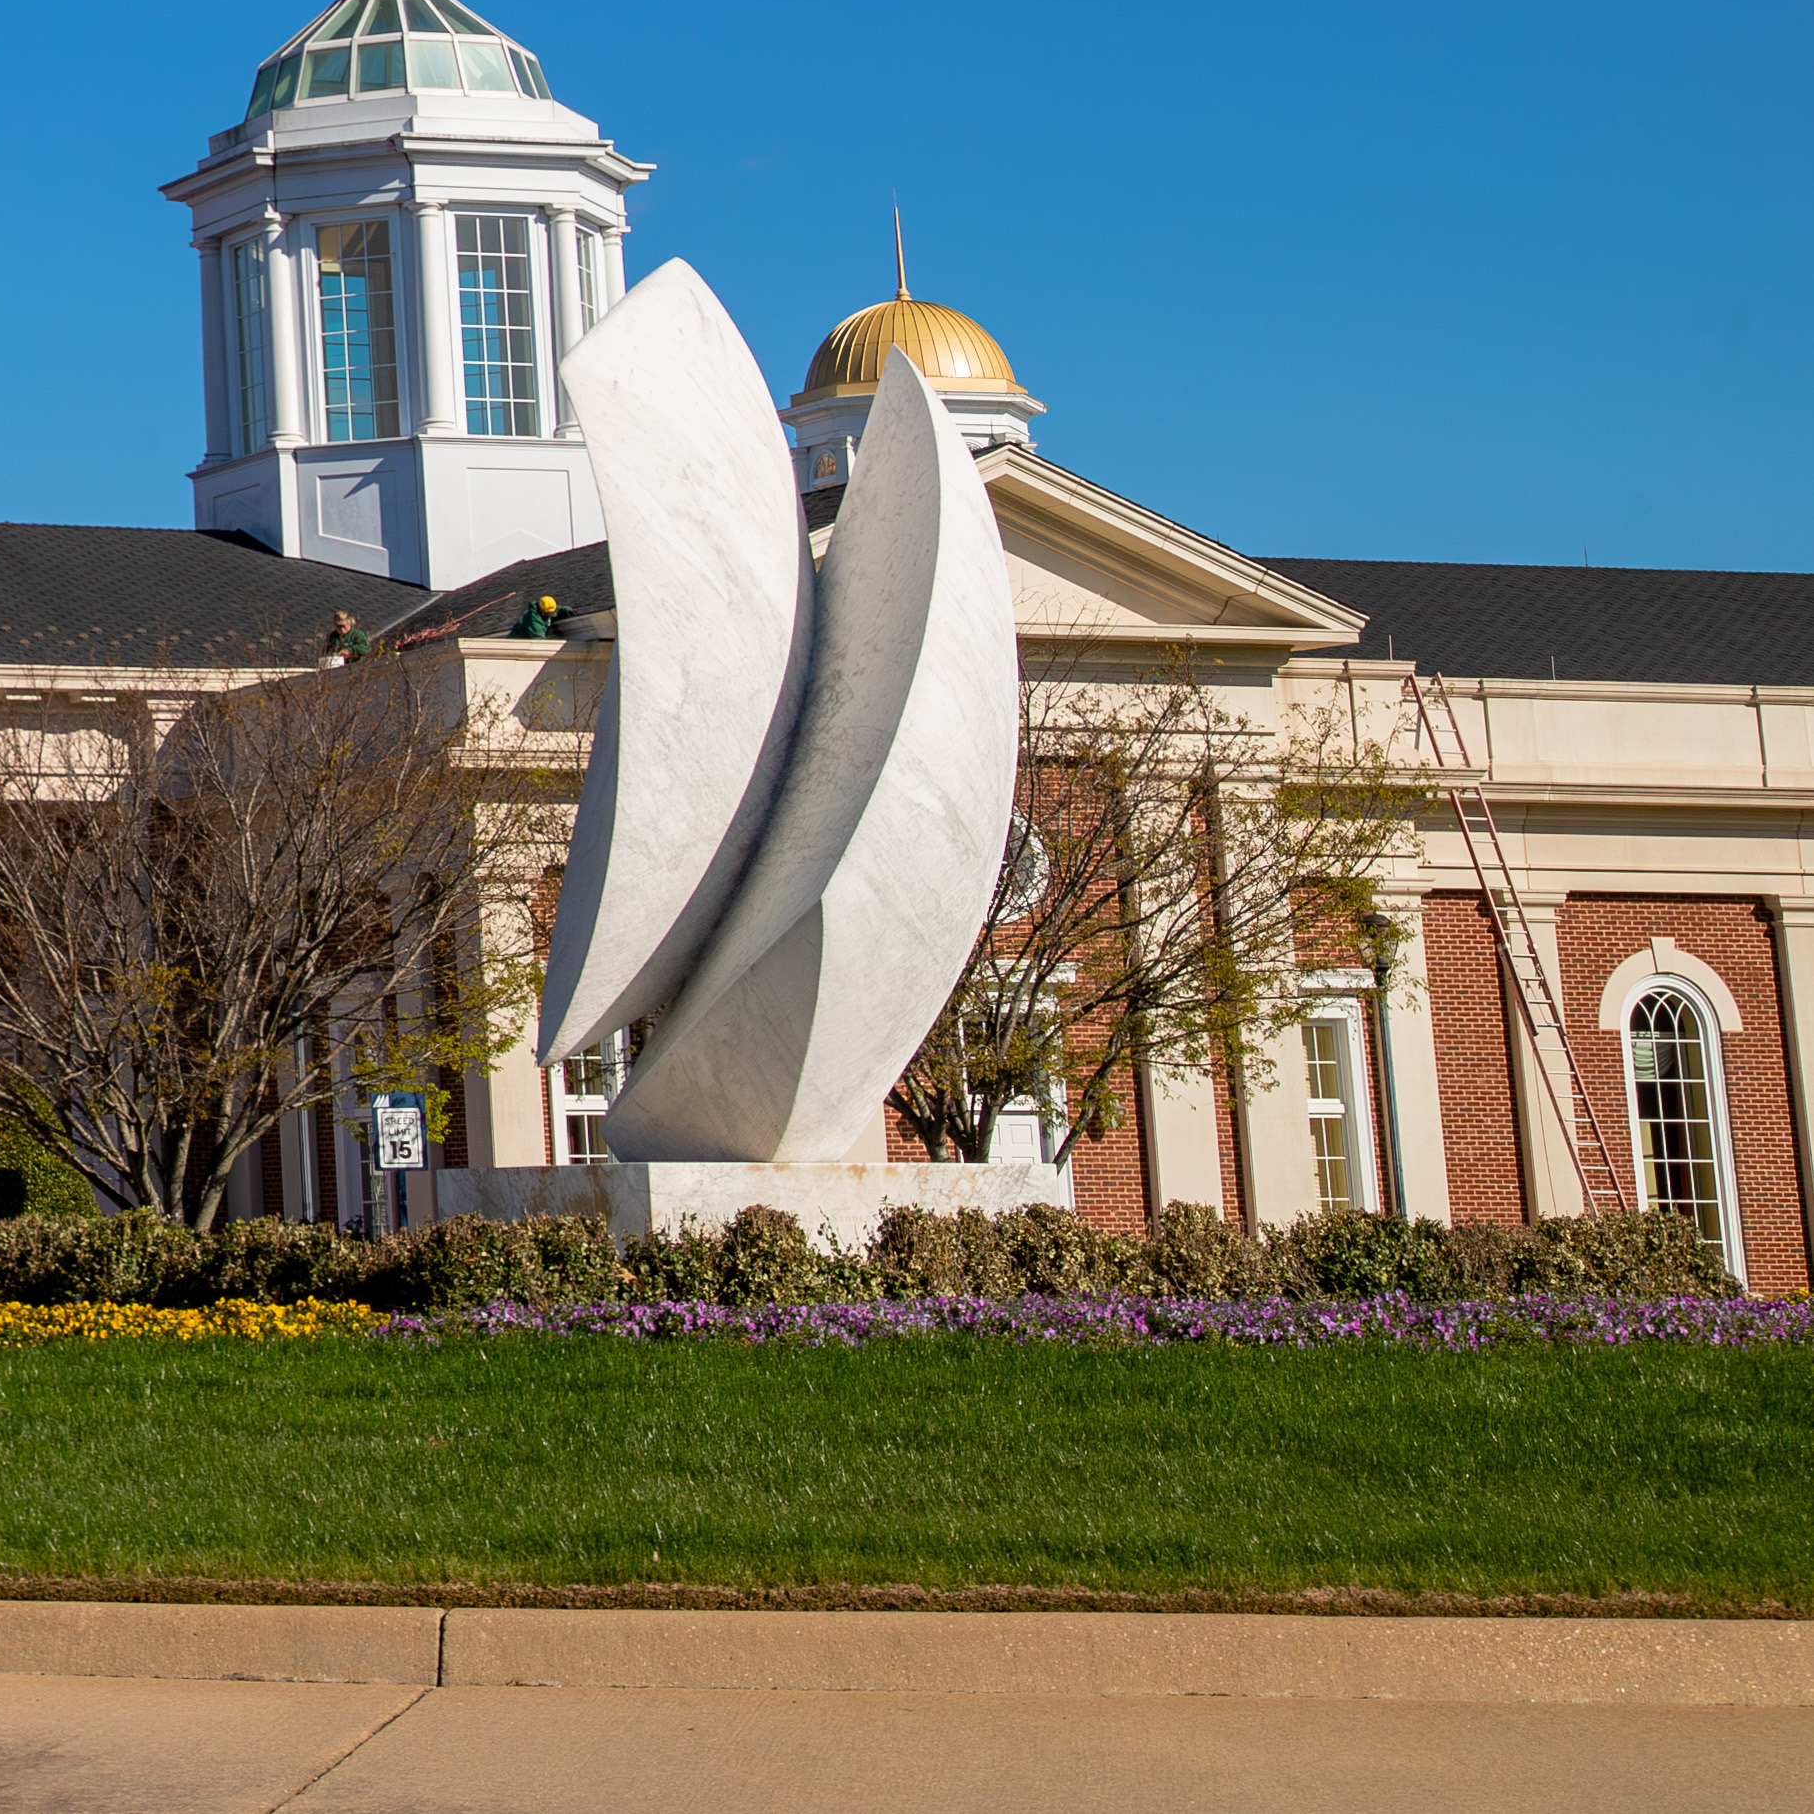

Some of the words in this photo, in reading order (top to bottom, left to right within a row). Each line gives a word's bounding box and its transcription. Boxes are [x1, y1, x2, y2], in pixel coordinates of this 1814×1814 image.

[384, 1116, 415, 1125] SPEED
[389, 1128, 411, 1136] LIMIT
[389, 1140, 412, 1159] 15
